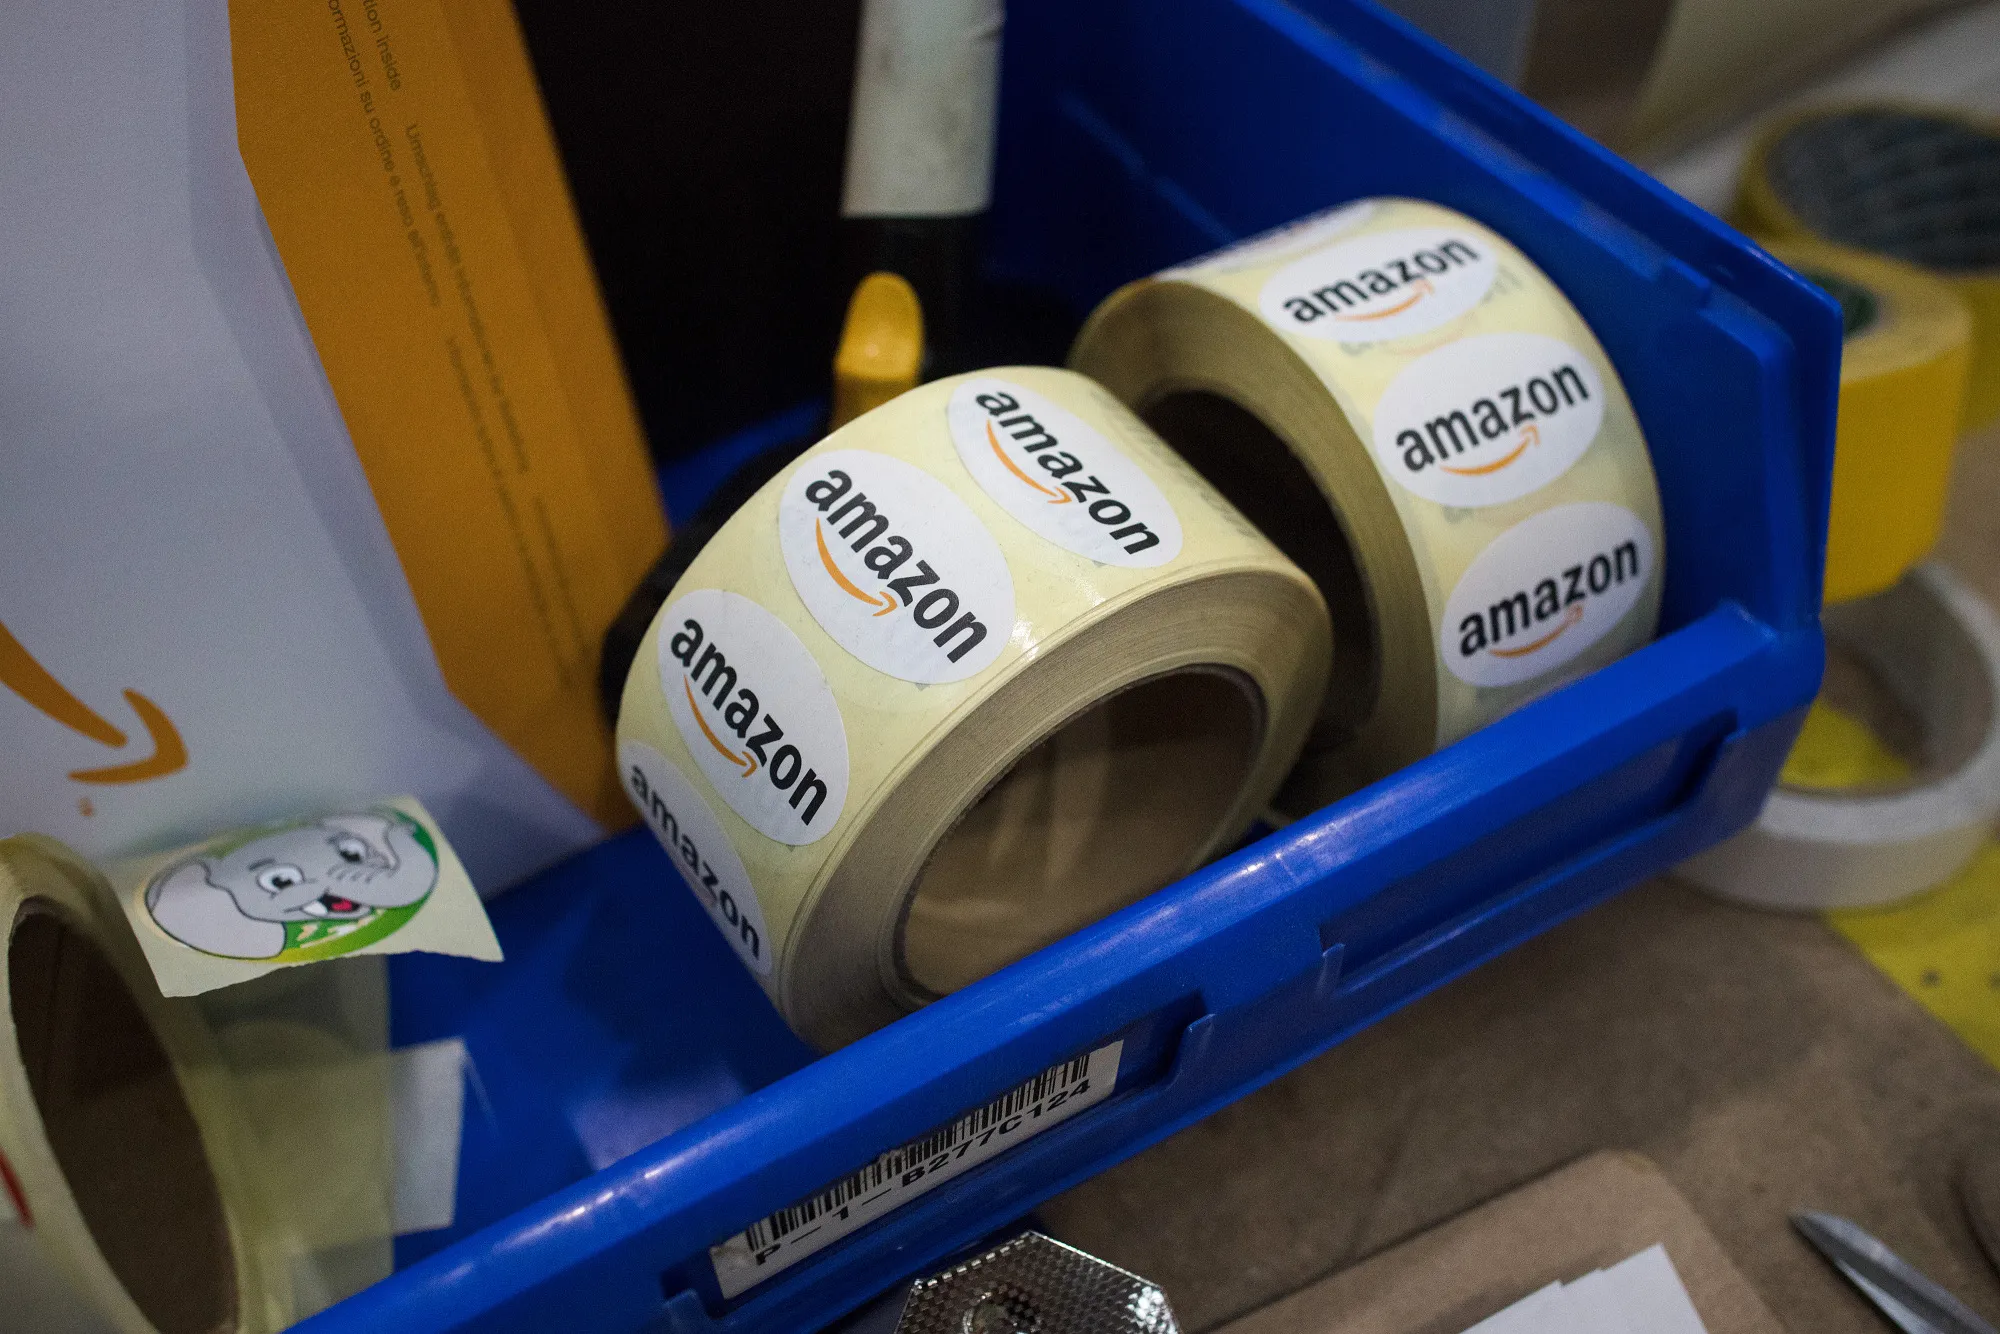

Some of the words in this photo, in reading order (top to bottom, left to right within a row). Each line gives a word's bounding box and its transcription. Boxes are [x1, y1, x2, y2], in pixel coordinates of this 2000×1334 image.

[376, 35, 401, 91] inside
[360, 91, 375, 114] su
[369, 117, 395, 172] ordine
[1283, 236, 1480, 323] amazon
[976, 390, 1160, 555] amazon
[1395, 362, 1589, 472] amazon
[806, 469, 988, 663] amazon
[1458, 540, 1639, 657] amazon
[669, 619, 828, 827] amazon
[630, 763, 761, 960] amazon
